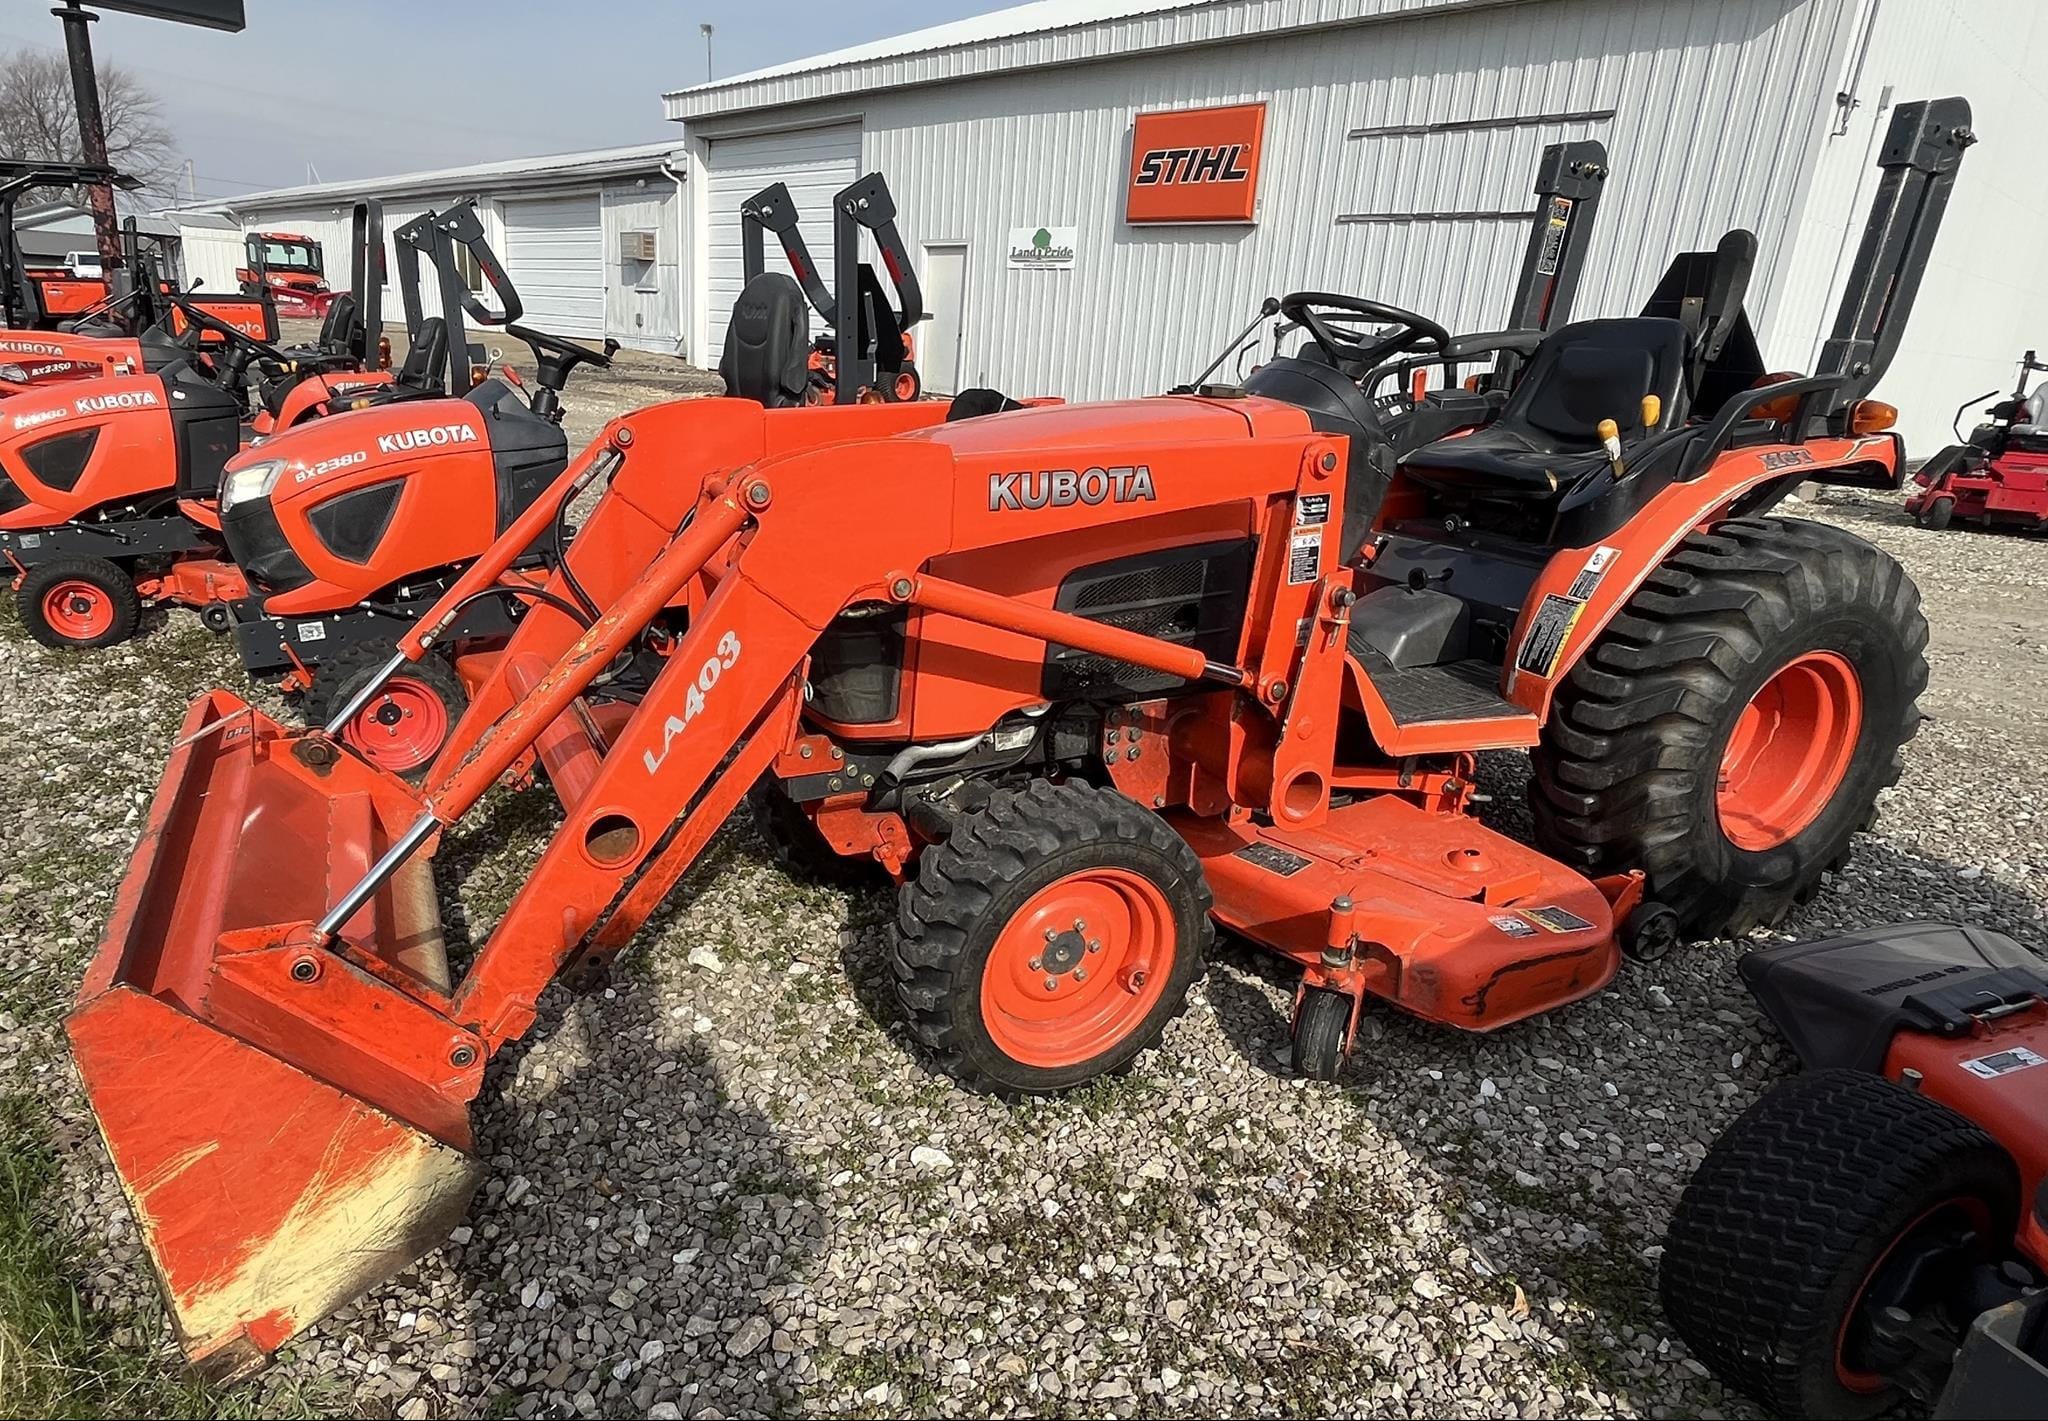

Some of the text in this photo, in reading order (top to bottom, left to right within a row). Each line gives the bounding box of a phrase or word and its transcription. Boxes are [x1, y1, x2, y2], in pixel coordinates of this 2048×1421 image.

[1134, 144, 1249, 186] STIHL
[1011, 246, 1073, 257] Land Pride
[0, 341, 64, 358] KUBOTA
[74, 391, 159, 415] KUBOTA
[376, 423, 478, 454] KUBOTA
[294, 450, 367, 483] BX2380
[989, 465, 1156, 511] KUBOTA
[643, 630, 742, 775] LA403
